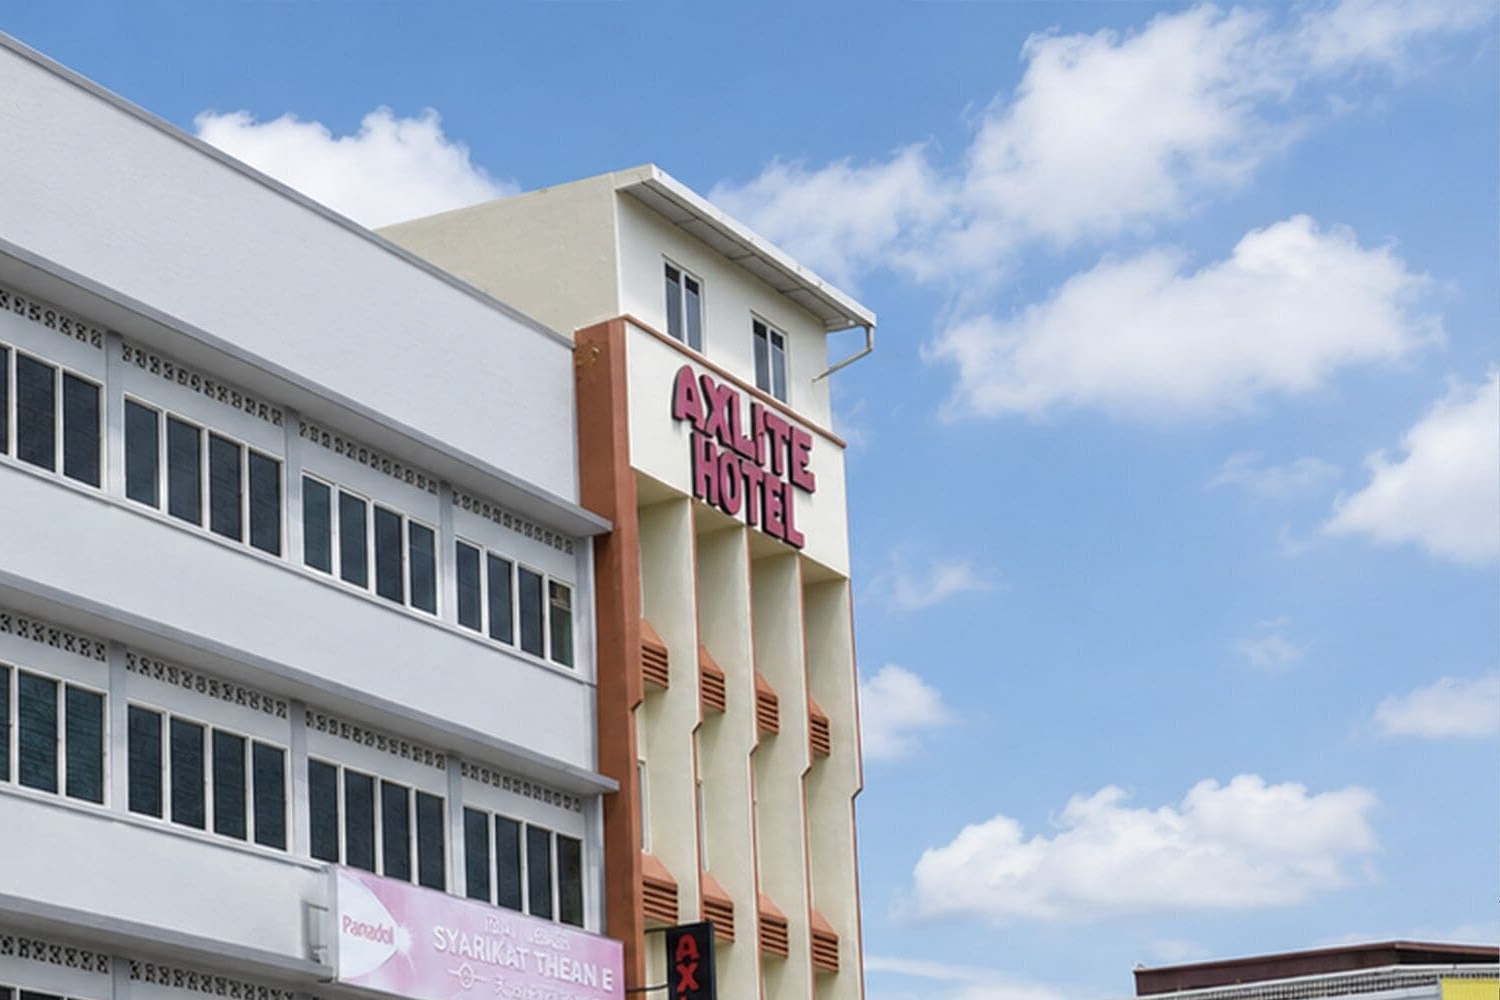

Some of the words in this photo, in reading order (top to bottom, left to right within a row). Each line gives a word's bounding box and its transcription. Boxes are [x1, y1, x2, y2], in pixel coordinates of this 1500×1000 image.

[672, 365, 816, 494] AXLITE
[690, 430, 804, 549] HOTEL
[342, 914, 394, 946] Panadol
[433, 926, 529, 973] SYARIKAT
[533, 951, 597, 990] THEAN
[602, 967, 615, 993] E
